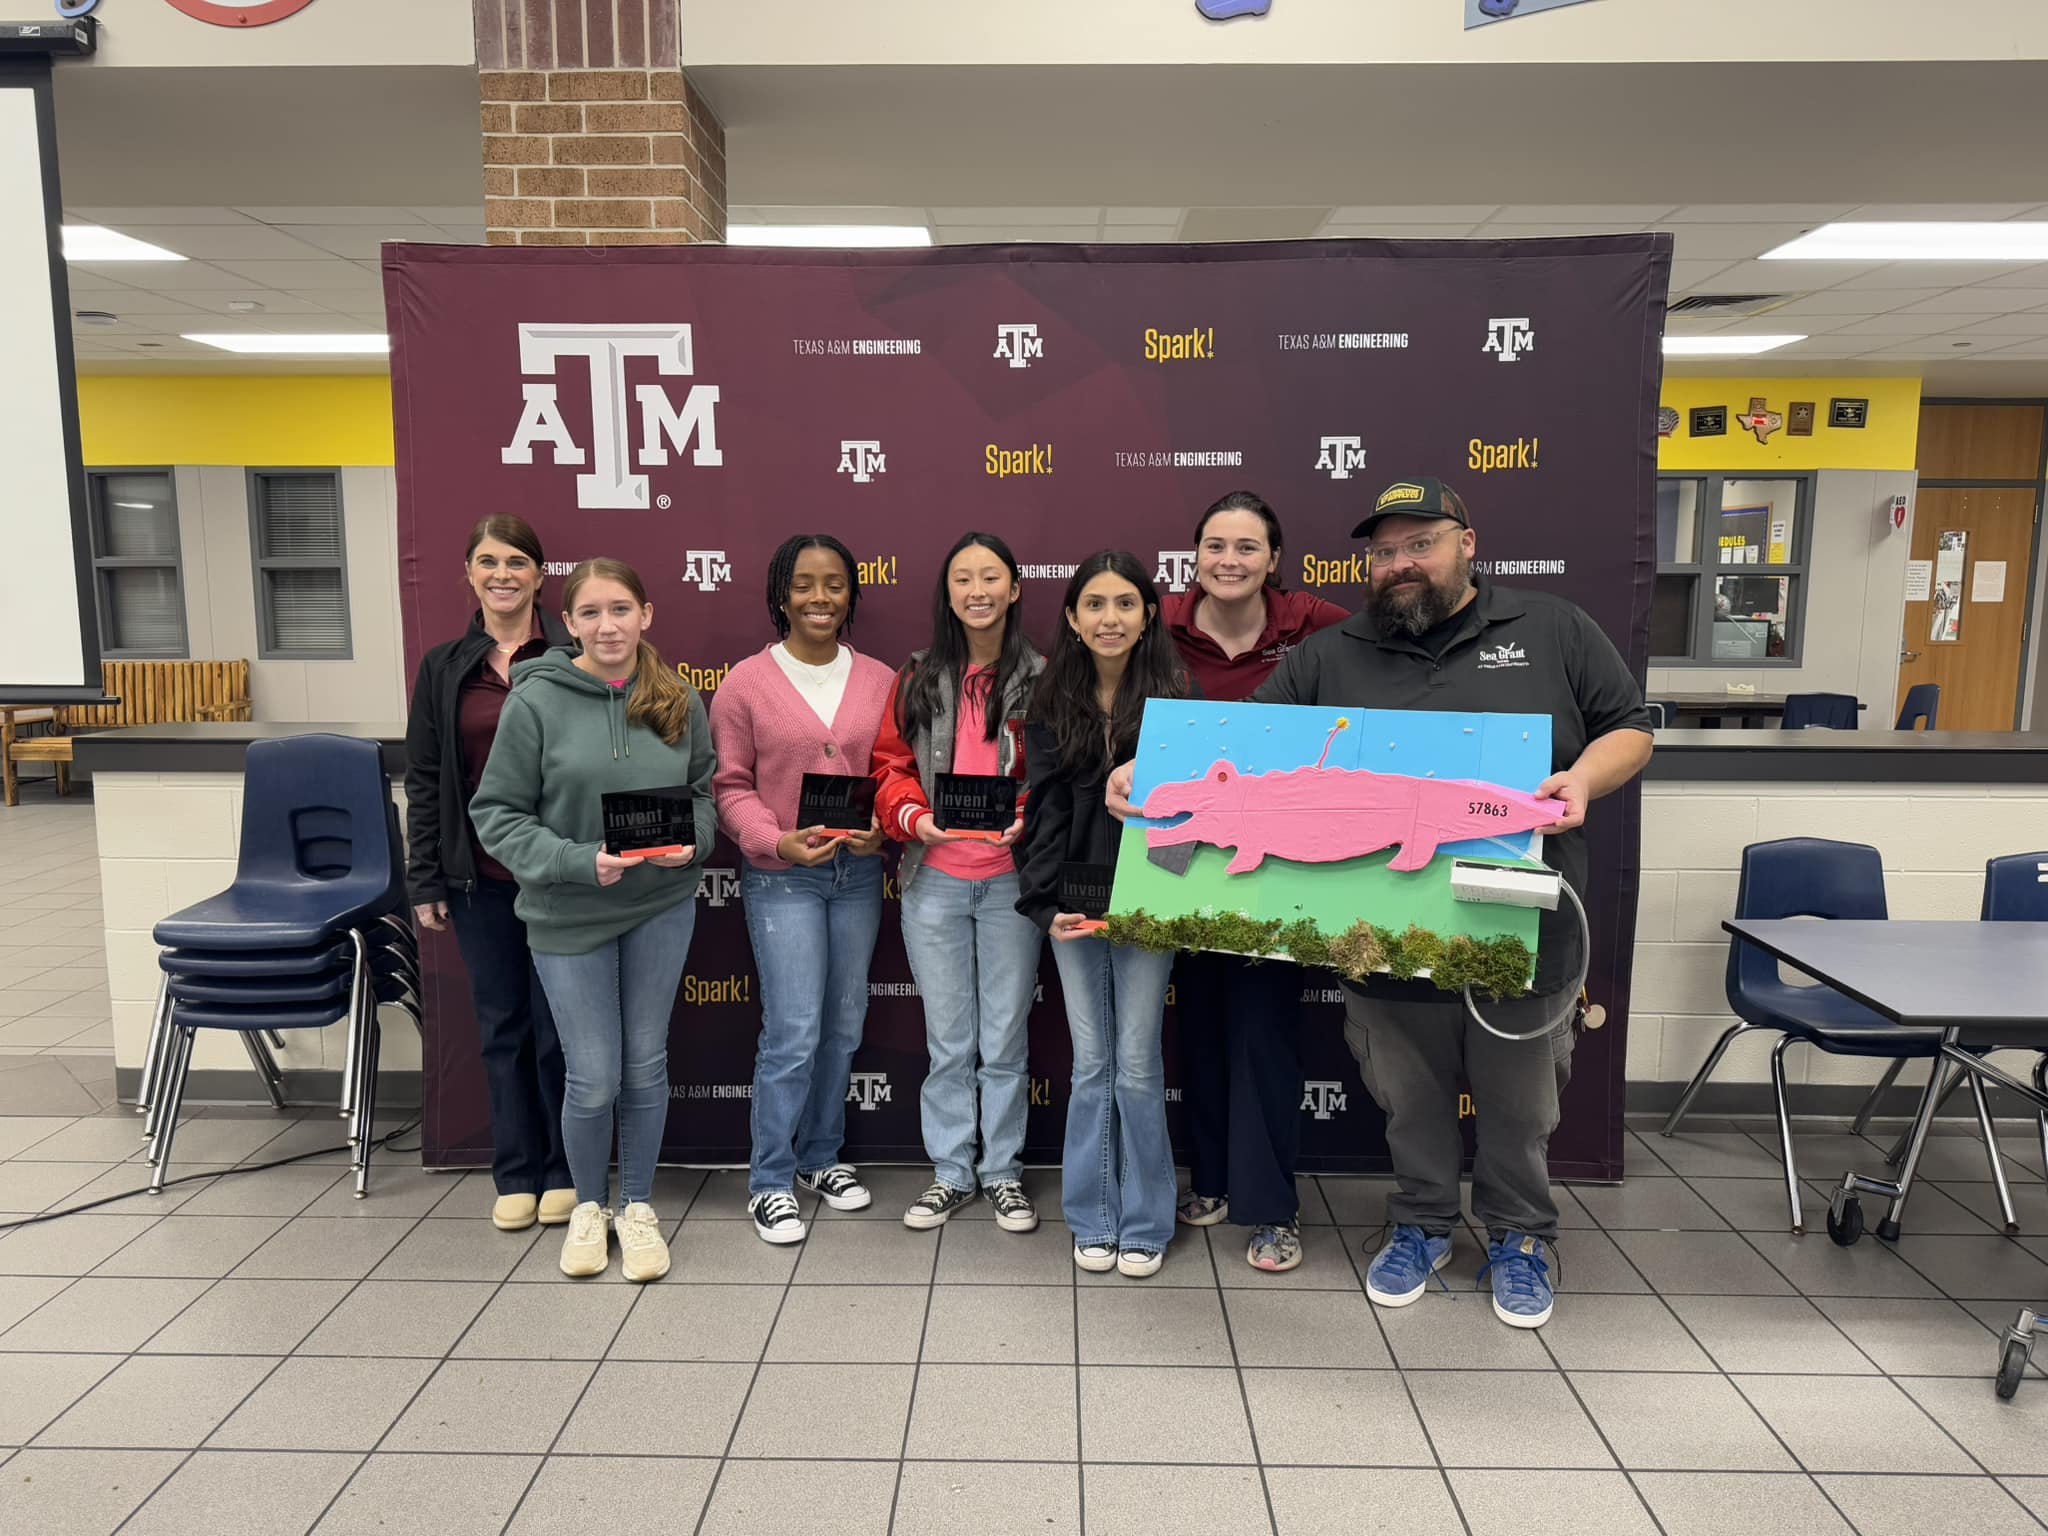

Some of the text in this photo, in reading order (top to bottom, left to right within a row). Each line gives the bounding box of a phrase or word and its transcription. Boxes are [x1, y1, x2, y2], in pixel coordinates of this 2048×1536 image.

[793, 339, 921, 354] TEXAS A&M ENGINEERING
[1145, 327, 1215, 364] Spark!
[1278, 333, 1409, 350] TEXAS A&M ENGINEERING
[986, 443, 1054, 478] Spark!
[1115, 451, 1243, 467] TEXAS A&M ENGINEERING
[1468, 437, 1539, 474] Spark!
[857, 555, 898, 586] ark!
[1303, 553, 1370, 588] Spark!
[1495, 559, 1565, 575] ENGINEERING
[1479, 647, 1526, 661] Sea Grant
[940, 791, 988, 809] Invent
[608, 808, 663, 828] Invent
[1468, 802, 1508, 817] 57863
[685, 974, 749, 1006] Spark!
[688, 1085, 710, 1098] A&M
[712, 1084, 753, 1098] ENGINEE
